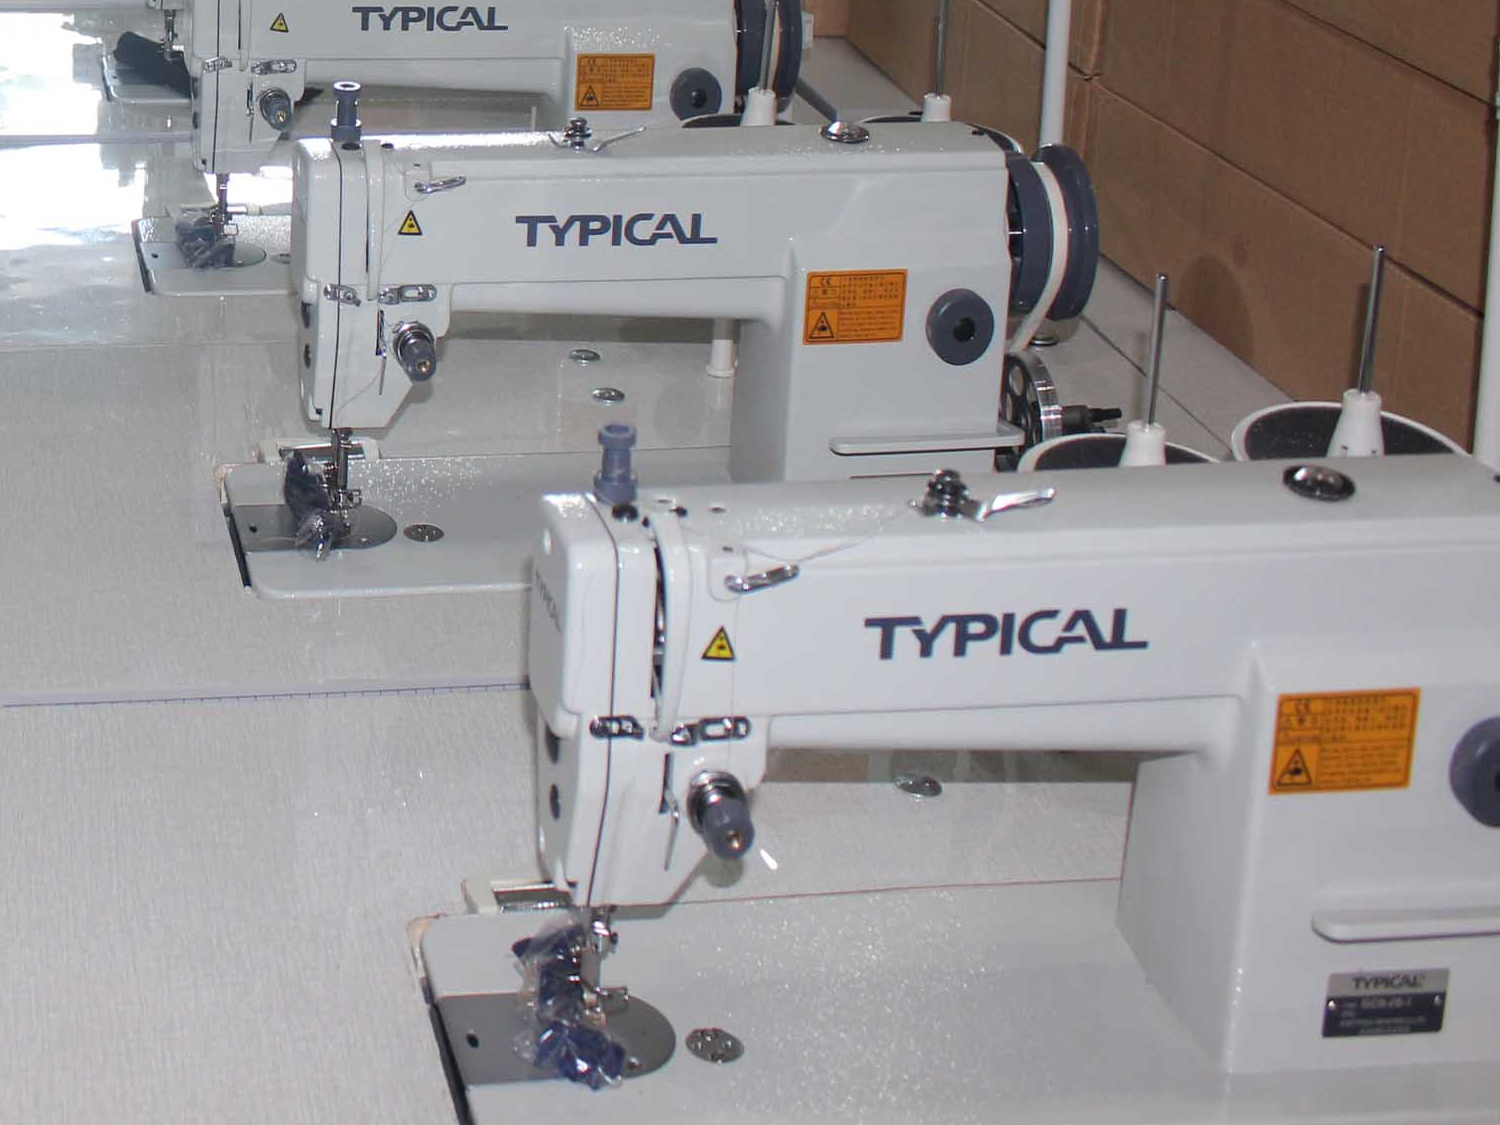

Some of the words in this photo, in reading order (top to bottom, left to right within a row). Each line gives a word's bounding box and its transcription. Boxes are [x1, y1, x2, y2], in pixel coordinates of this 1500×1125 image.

[352, 5, 508, 32] TYPICAL
[516, 212, 717, 248] TYPICAL
[864, 608, 1149, 660] TYPICAL
